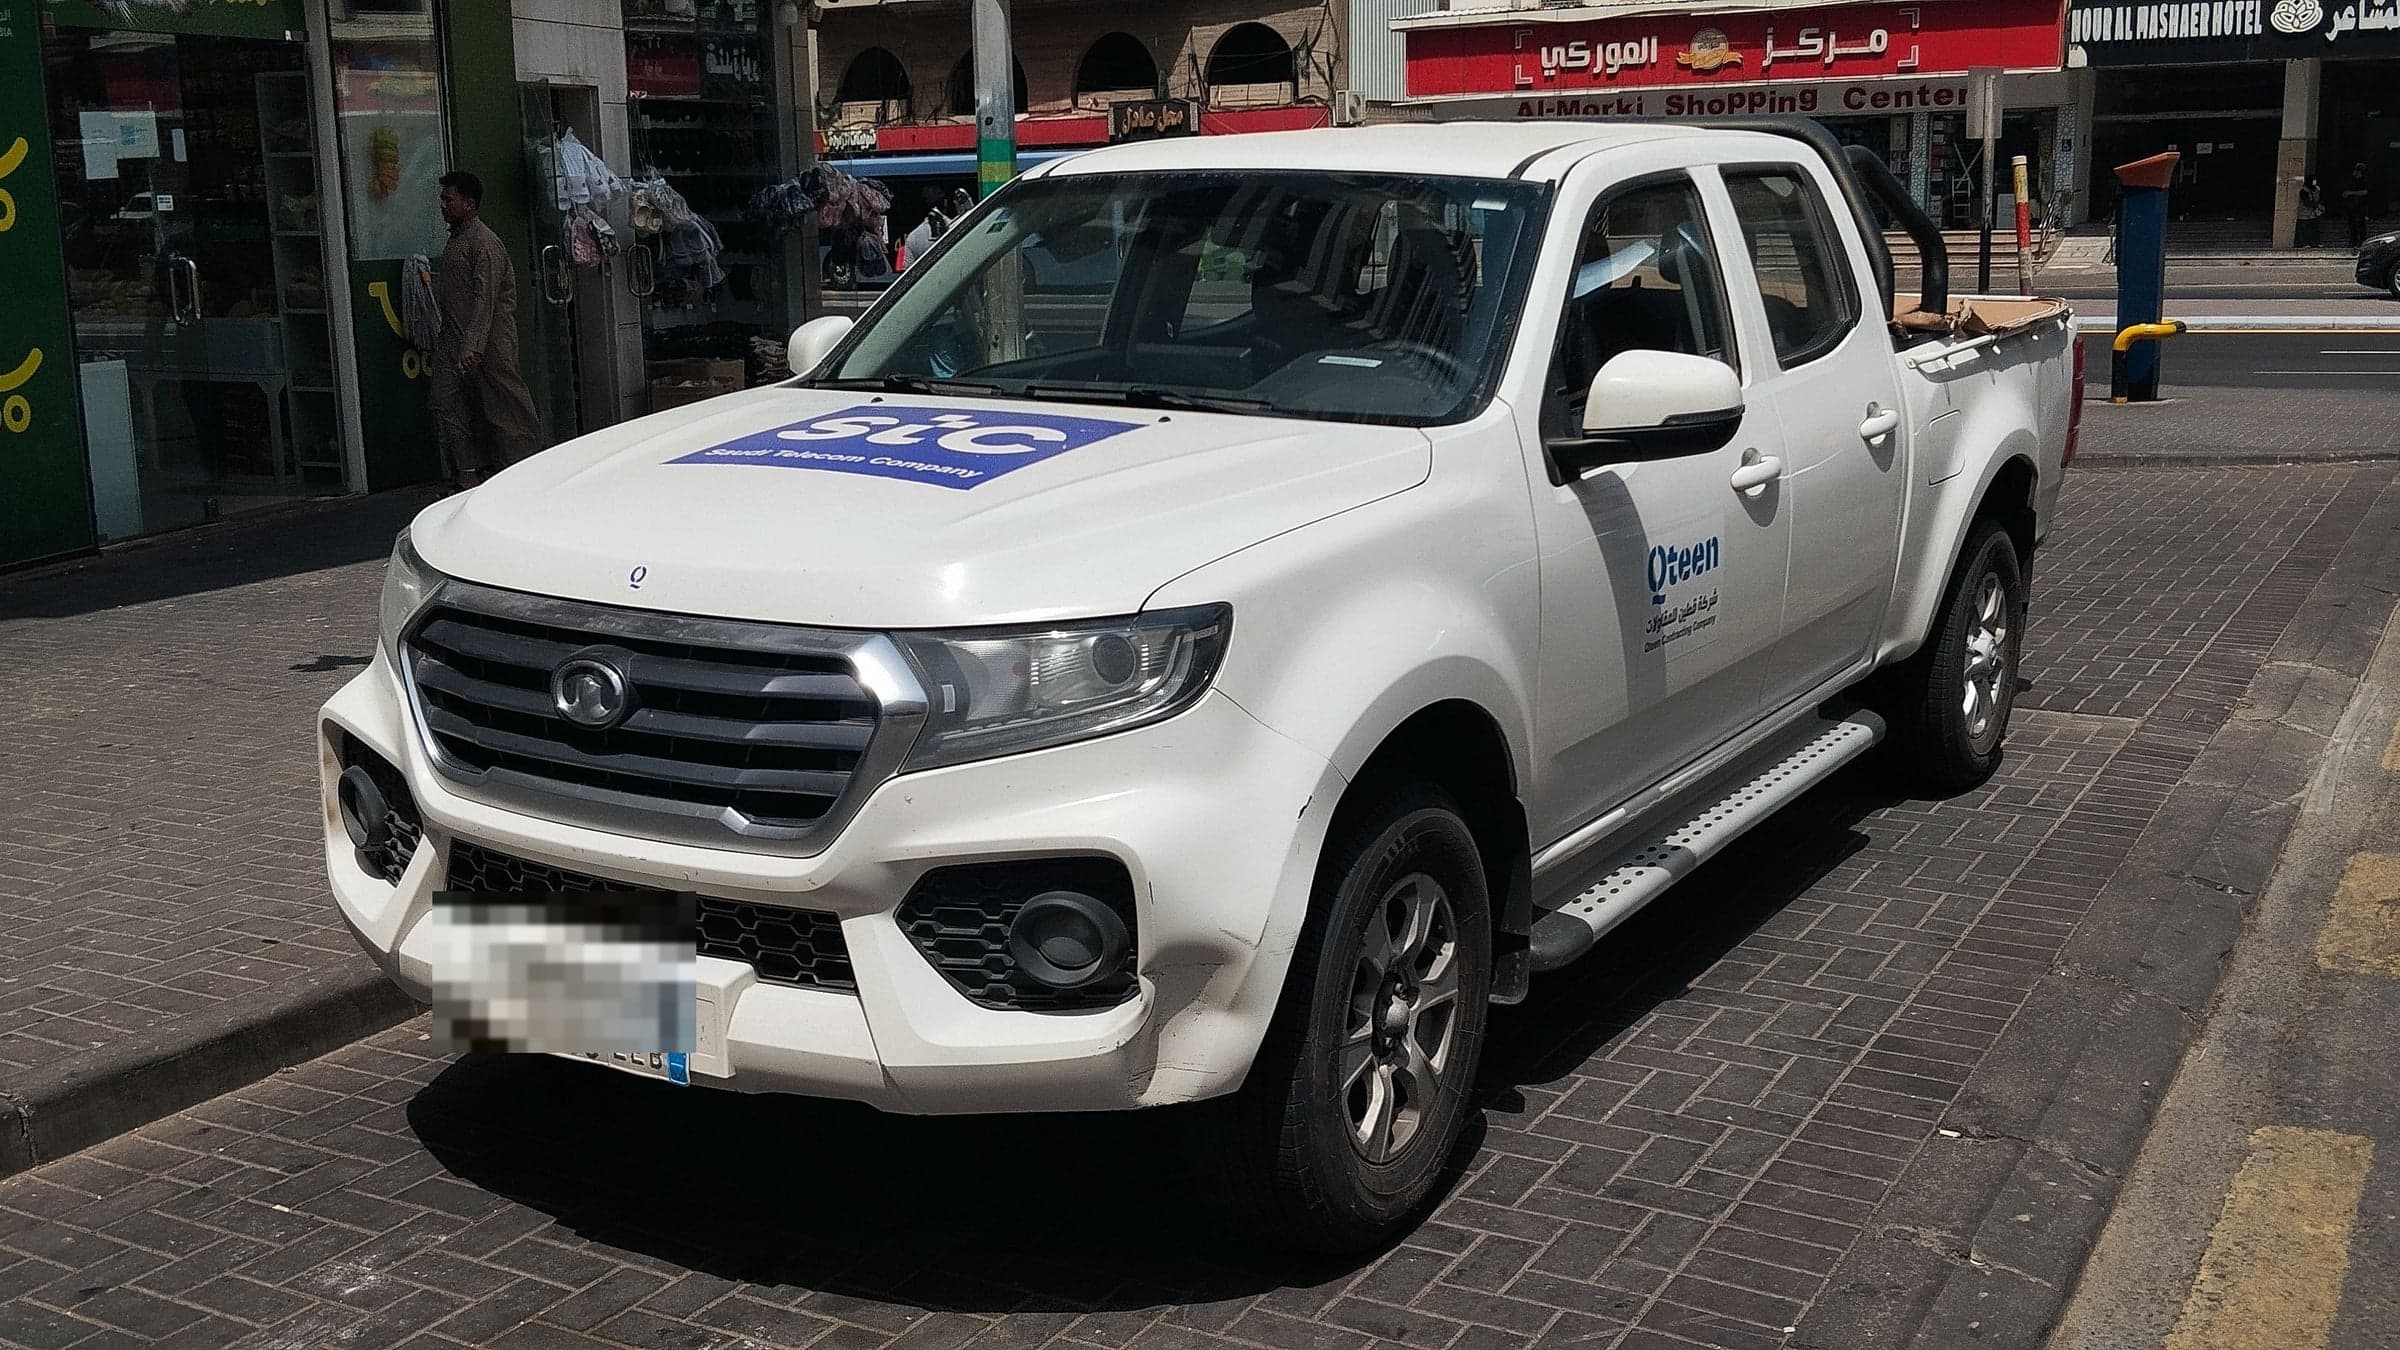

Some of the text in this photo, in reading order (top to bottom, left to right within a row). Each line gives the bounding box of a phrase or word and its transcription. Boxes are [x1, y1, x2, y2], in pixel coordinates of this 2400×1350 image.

[2071, 0, 2262, 43] NOUR AL MASHAER HOTEL
[1540, 36, 1658, 77] الموركي
[1762, 25, 1889, 67] مركز
[1517, 95, 1644, 117] Al-Morki
[1664, 83, 1819, 117] Shopping
[1121, 104, 1185, 136] محل عادل
[704, 448, 984, 480] Saudi Telecom Company
[1647, 535, 1719, 606] Qteen
[1697, 587, 1719, 612] شركة
